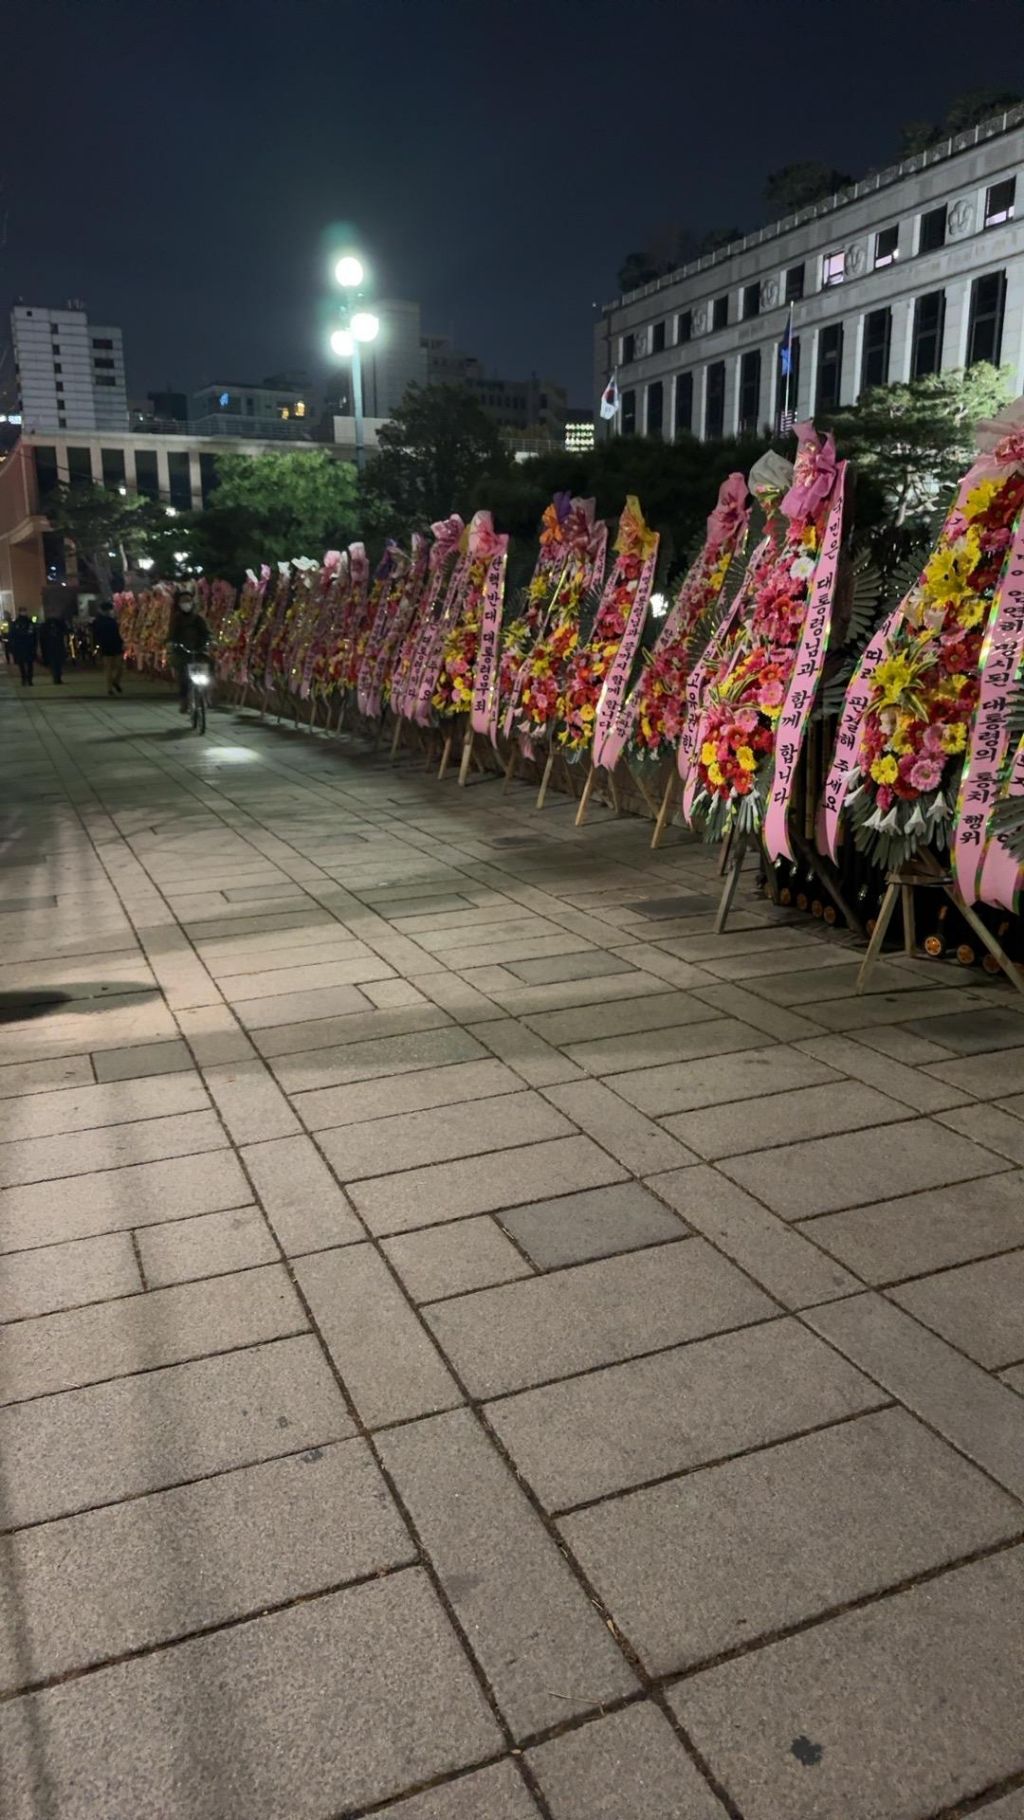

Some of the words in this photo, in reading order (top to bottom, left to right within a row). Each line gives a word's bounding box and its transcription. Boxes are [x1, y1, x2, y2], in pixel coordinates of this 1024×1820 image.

[797, 572, 833, 677] 대통령님과
[984, 641, 1018, 687] 명시된
[781, 690, 810, 728] 함께
[975, 697, 1007, 763] 대통령의
[774, 743, 798, 806] 합니다
[822, 759, 849, 813] 주세요
[967, 772, 996, 804] 통치
[960, 814, 984, 846] 행위
